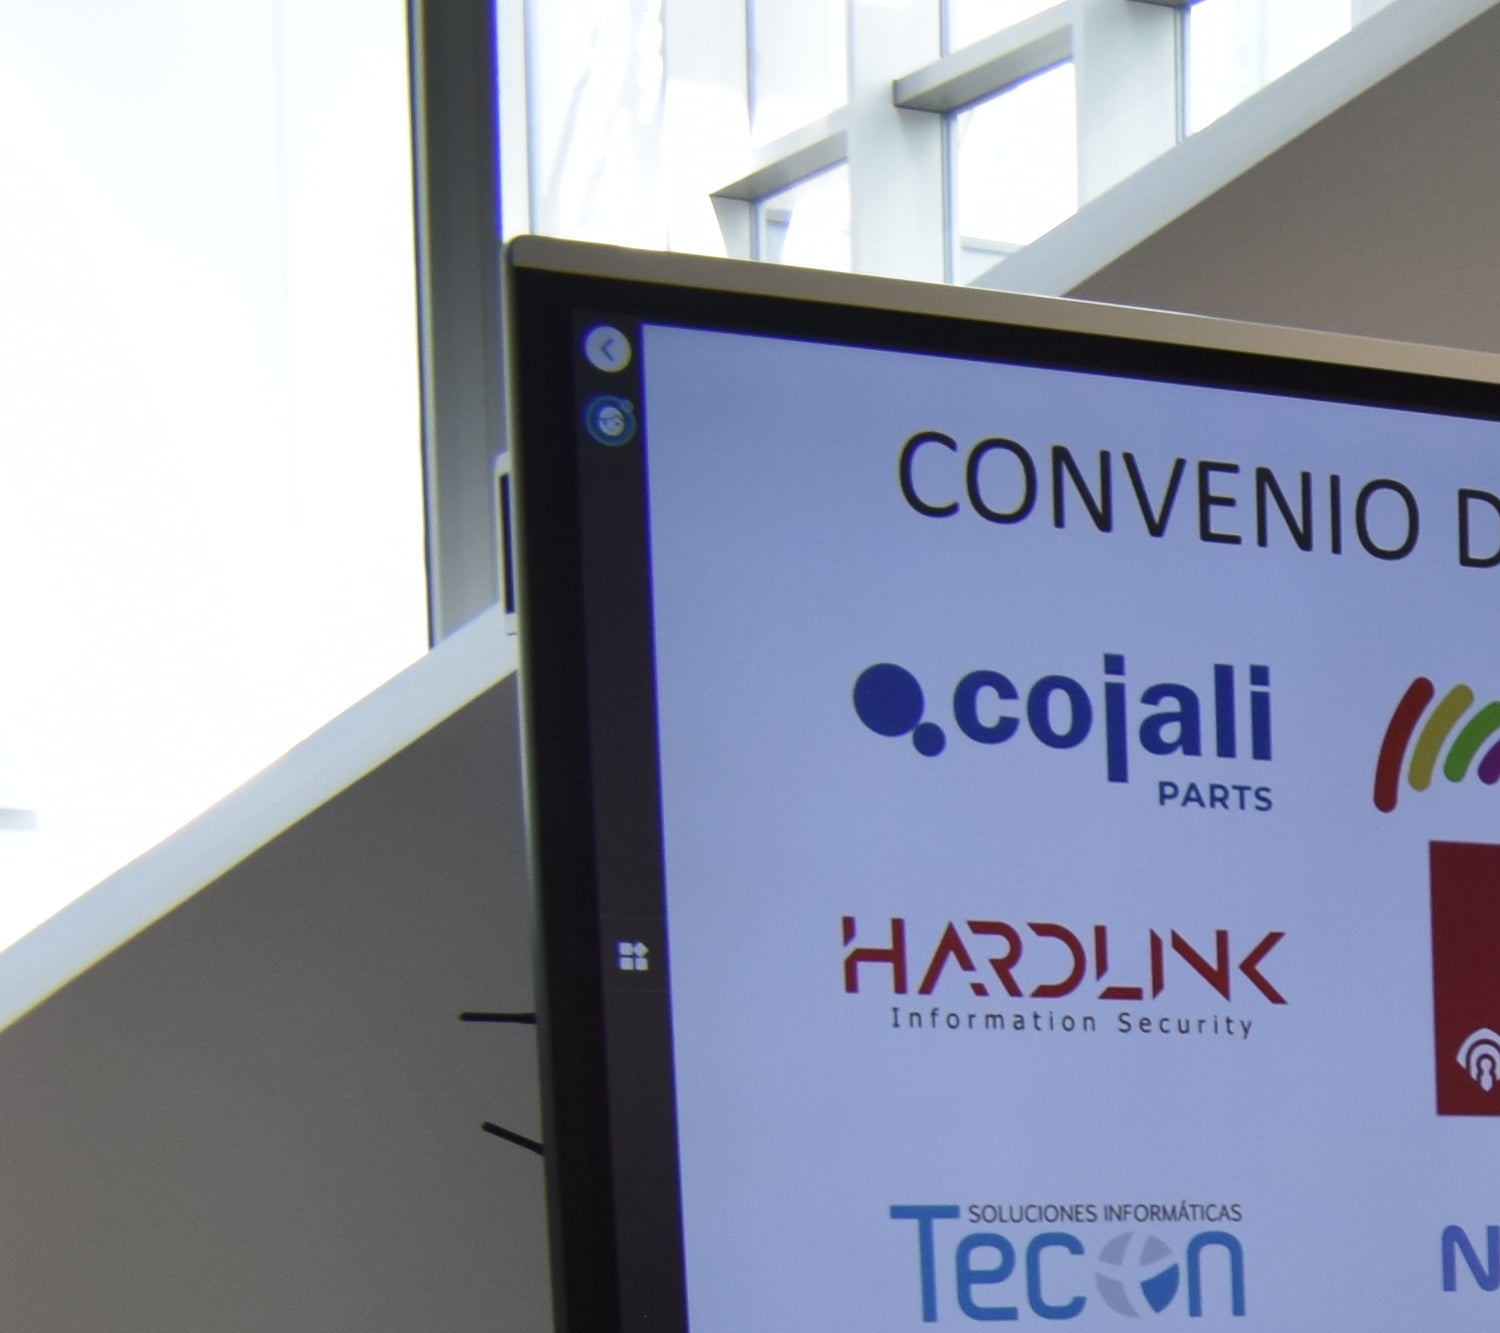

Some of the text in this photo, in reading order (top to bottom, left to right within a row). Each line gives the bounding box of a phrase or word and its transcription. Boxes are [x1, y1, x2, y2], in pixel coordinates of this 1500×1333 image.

[898, 430, 1420, 561] CONVENIO
[952, 653, 1272, 783] cojali
[1157, 780, 1272, 811] PARTS
[841, 915, 1288, 1005] HARDLINK
[891, 1008, 1253, 1040] Information Security
[968, 1200, 1243, 1224] SOLUCIONES INFORMÁTICAS
